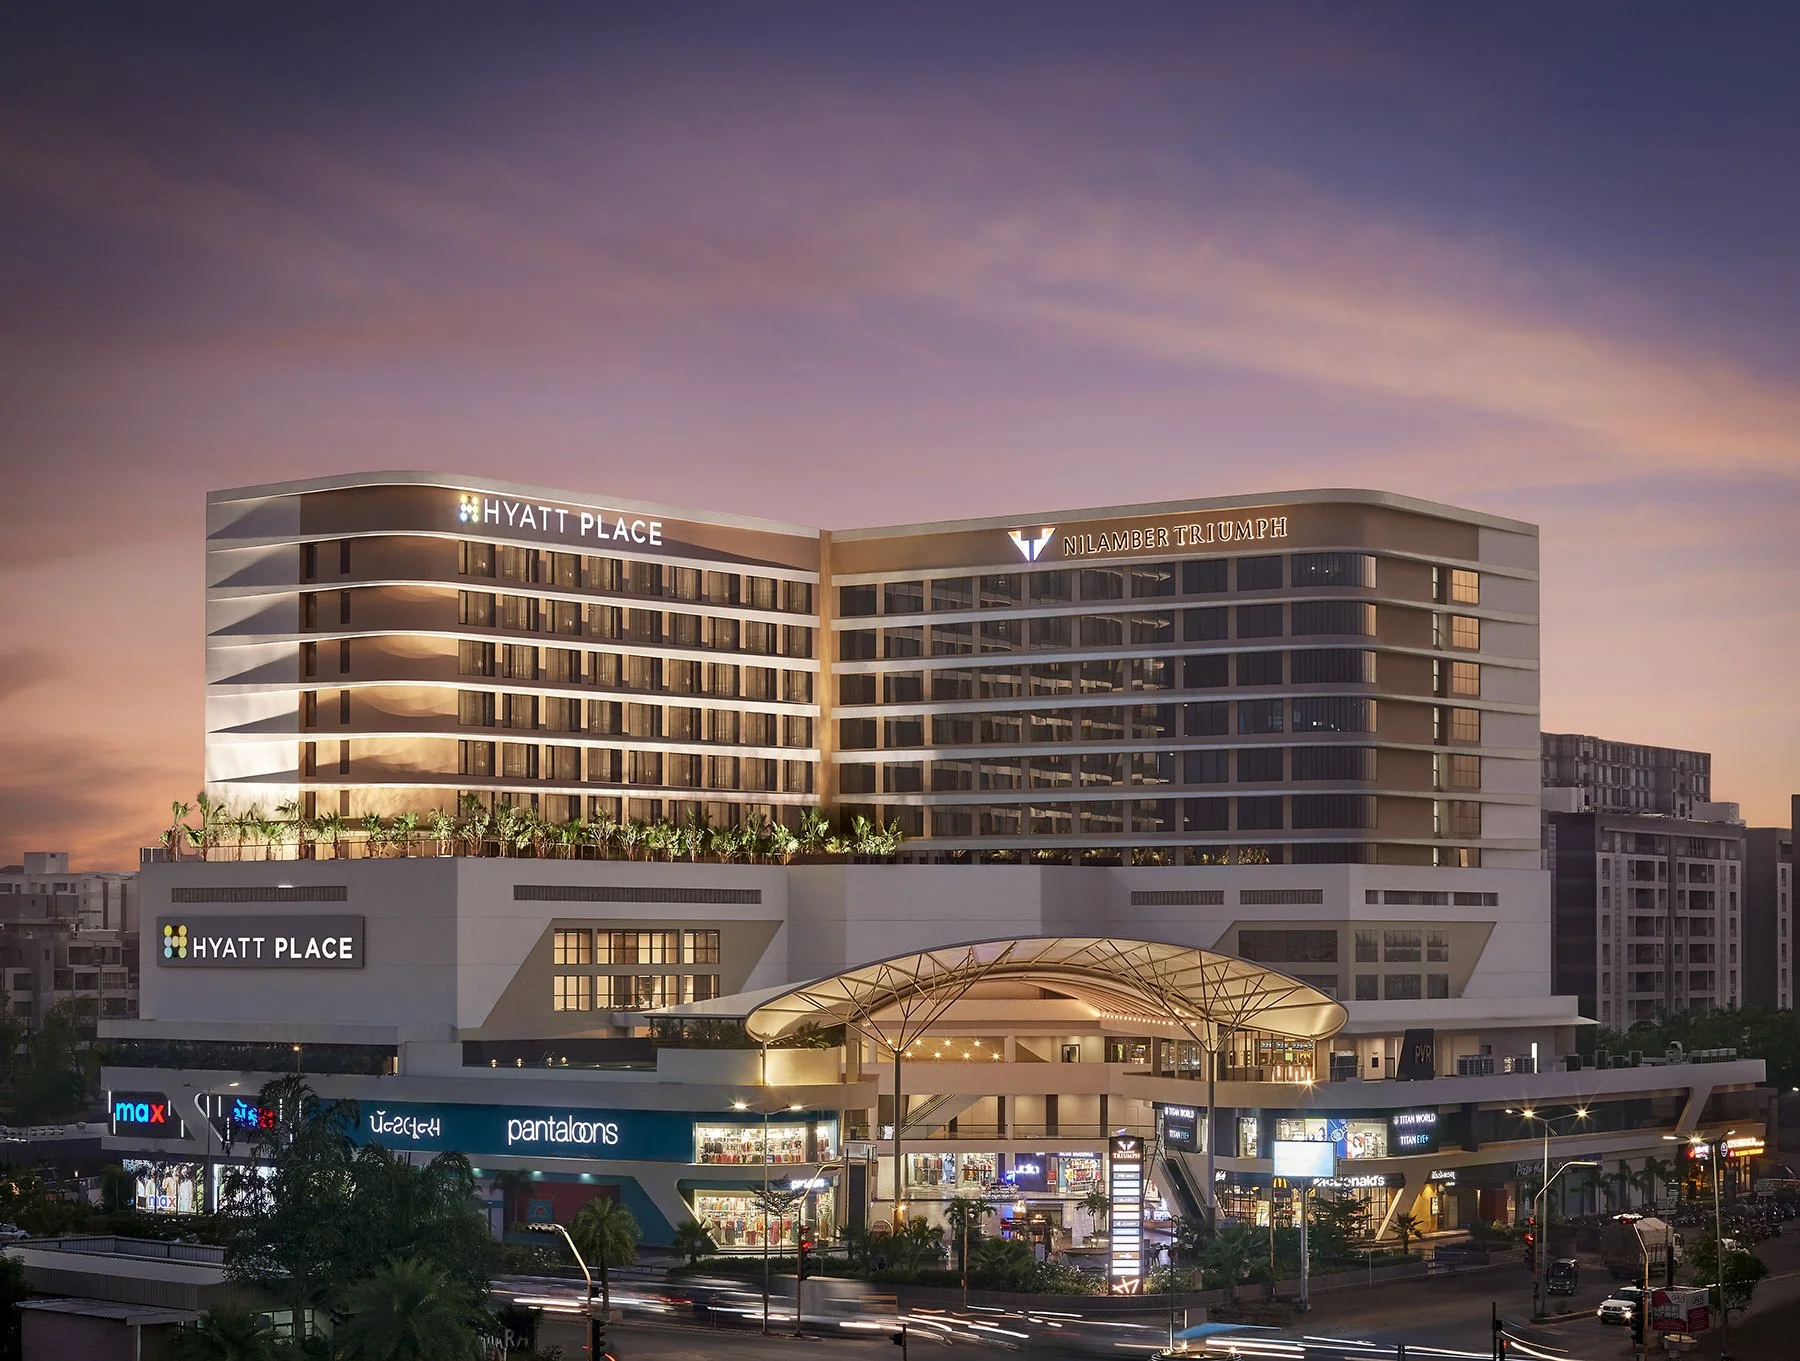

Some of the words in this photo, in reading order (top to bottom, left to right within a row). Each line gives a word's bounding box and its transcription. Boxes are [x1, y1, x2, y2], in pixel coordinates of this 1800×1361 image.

[484, 498, 569, 534] HYATT
[580, 511, 663, 547] PLACE
[1064, 527, 1169, 556] NILAMBER
[1173, 517, 1287, 546] TRIUMPH
[193, 937, 266, 959] HYATT
[275, 937, 353, 959] PLACE
[1415, 1044, 1432, 1064] PVR
[115, 1102, 165, 1123] max
[1400, 1115, 1415, 1125] TITAN
[1416, 1113, 1436, 1123] WORLD
[508, 1115, 619, 1145] pantaloons
[1400, 1135, 1416, 1145] TITAN
[148, 1195, 176, 1208] max
